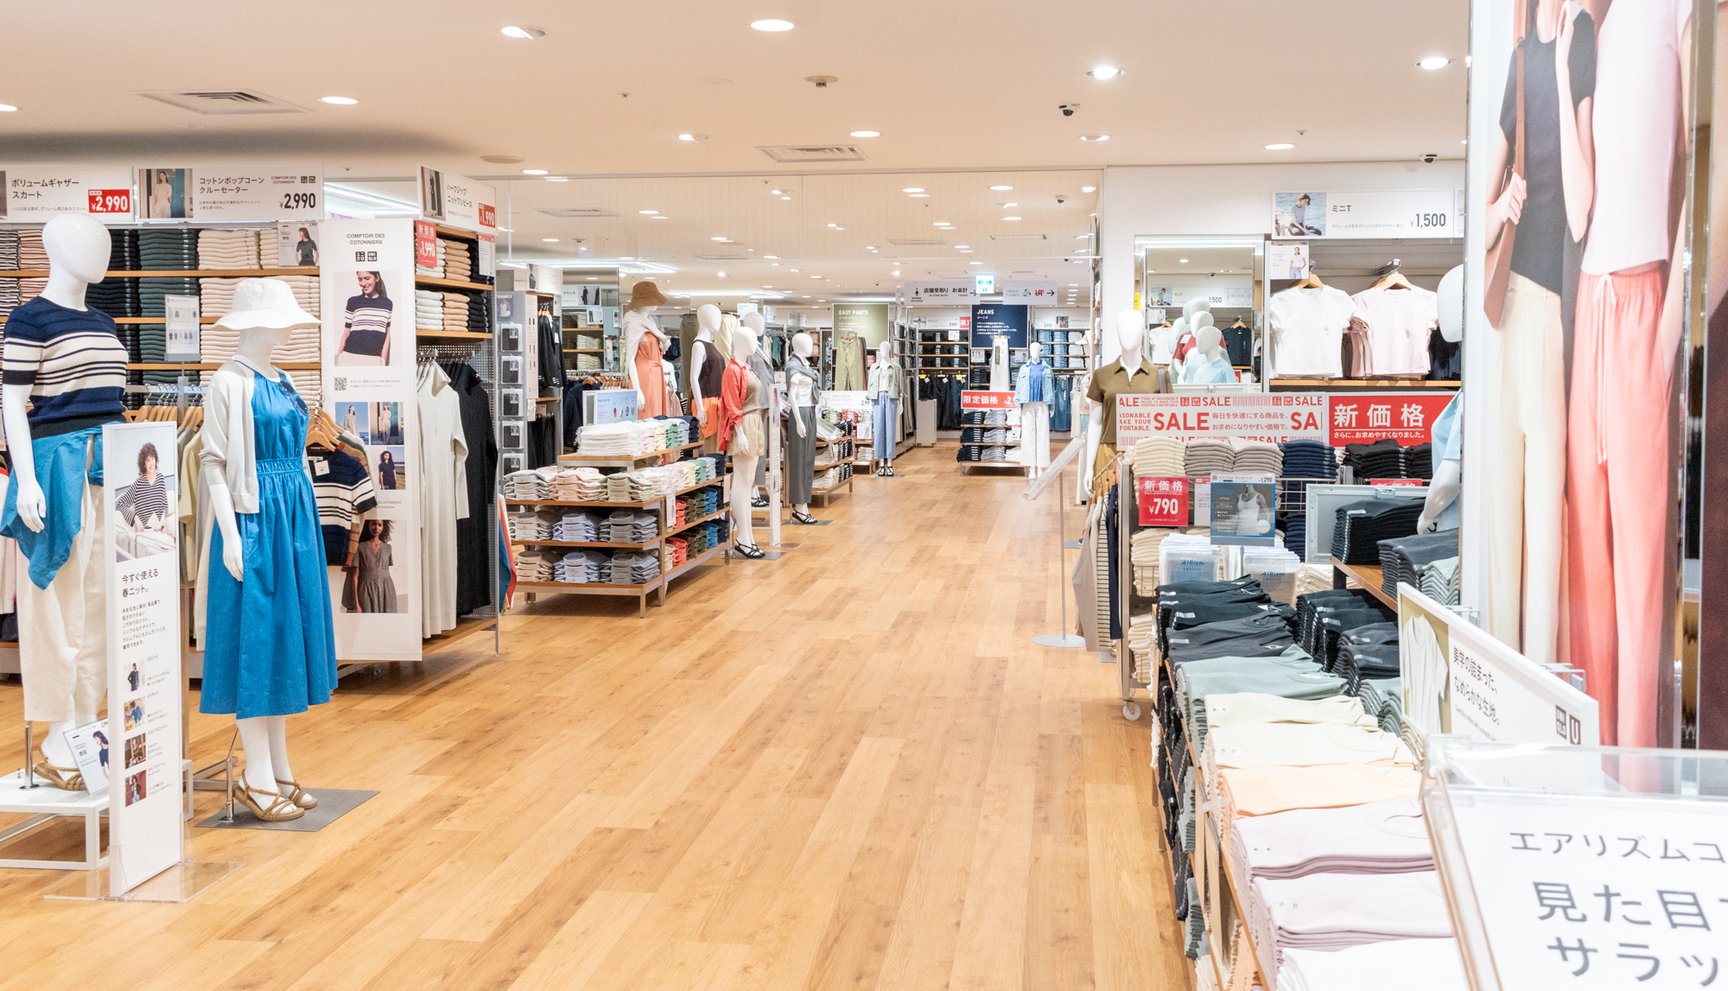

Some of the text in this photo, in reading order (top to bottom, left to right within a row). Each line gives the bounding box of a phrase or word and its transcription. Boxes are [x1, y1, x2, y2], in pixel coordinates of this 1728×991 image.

[12, 178, 79, 187] ボリュームギャザー
[199, 177, 265, 185] コットンポップコーン
[12, 190, 42, 199] スカート
[199, 186, 248, 194] クルーセーター
[91, 195, 129, 213] ¥2,990
[280, 193, 316, 210] ¥2,990
[1332, 204, 1352, 213] ミニT
[1410, 213, 1446, 229] ¥1,500
[963, 395, 998, 405] 限定価格
[1202, 397, 1231, 407] SALE
[1295, 396, 1322, 406] SALE
[1153, 412, 1210, 431] SALE
[1290, 411, 1323, 431] SA
[1334, 403, 1425, 427] 新価格
[1144, 480, 1183, 492] 新価格
[1149, 498, 1179, 515] ¥790
[122, 568, 159, 584] 今すぐ使える
[122, 585, 149, 598] 春ニット。
[1509, 832, 1726, 863] エアリズムコ
[1532, 881, 1728, 932] 見た目
[1547, 936, 1719, 987] サラッ
